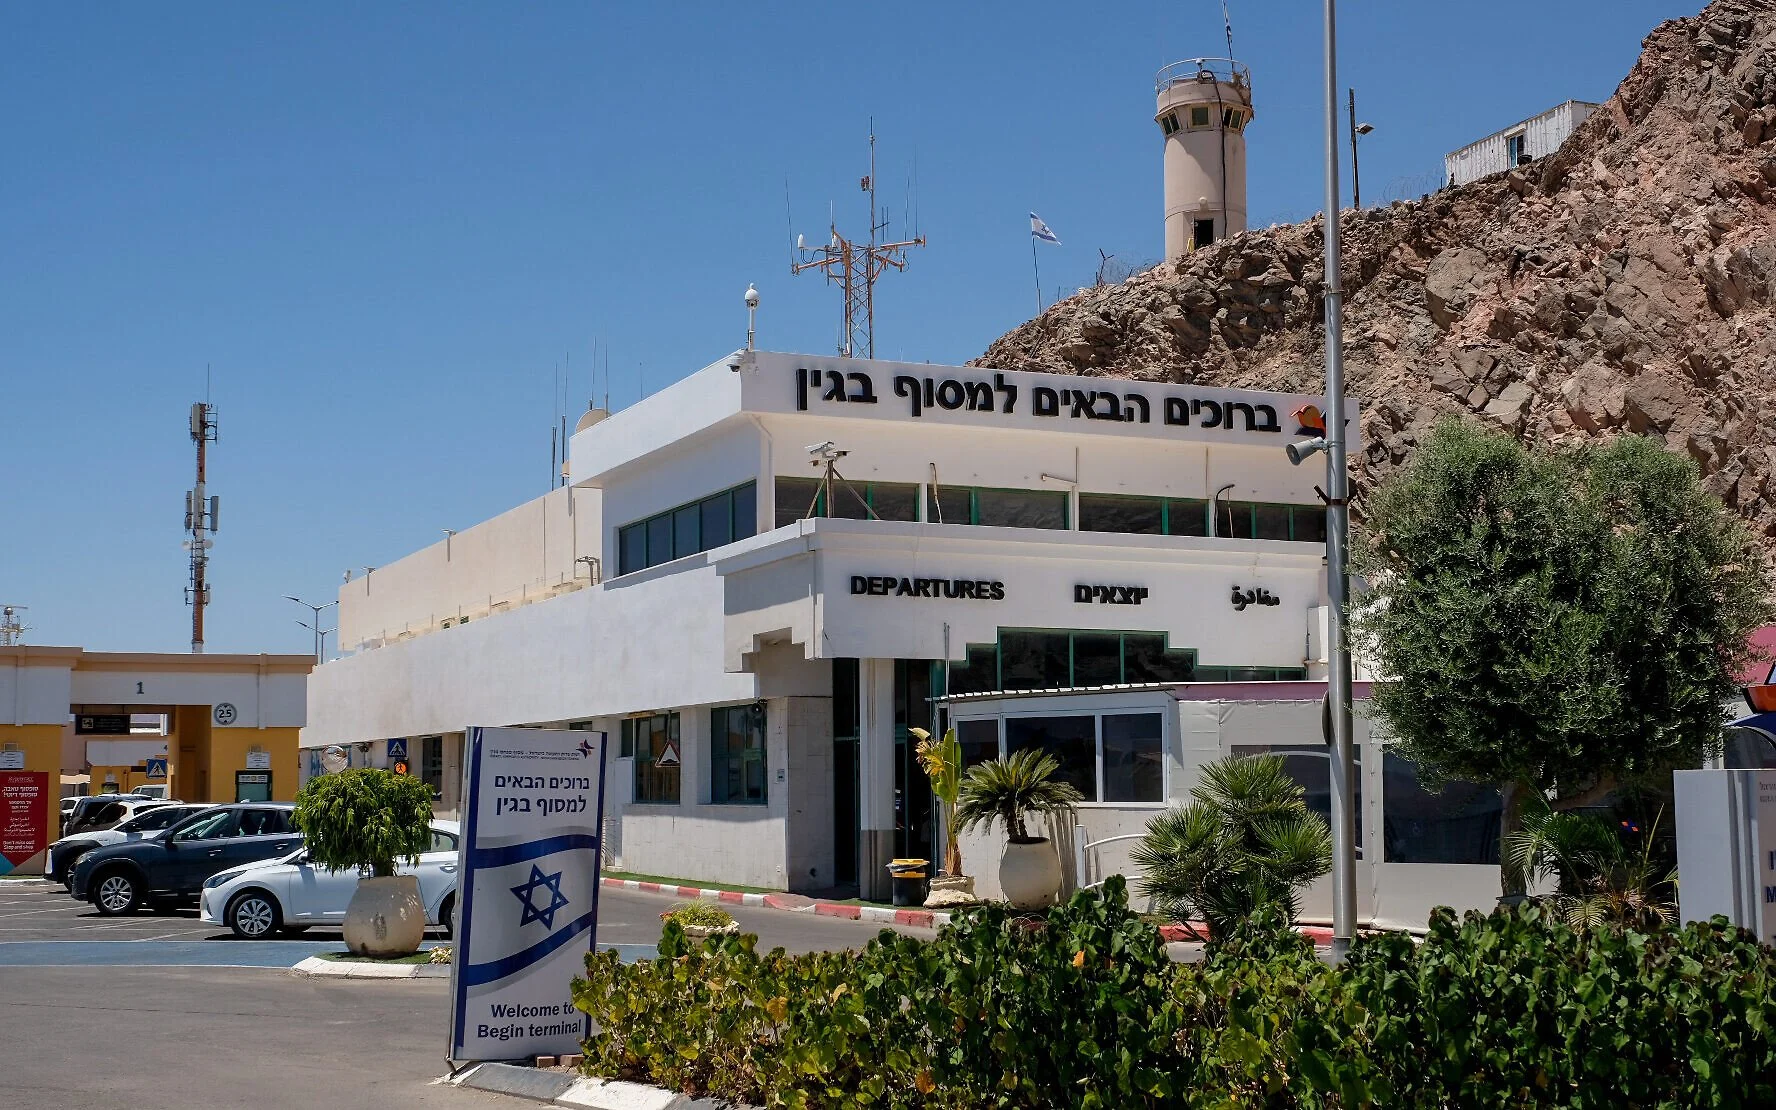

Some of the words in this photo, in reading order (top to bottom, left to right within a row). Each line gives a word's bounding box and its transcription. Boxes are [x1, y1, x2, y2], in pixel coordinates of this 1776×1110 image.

[796, 368, 878, 411] בגין
[893, 373, 1018, 417] למסוף
[1032, 386, 1150, 423] הבאים
[1164, 396, 1281, 433] ברוכים
[850, 575, 1005, 600] DEPARTURES
[1074, 584, 1149, 605] יוצאים
[1231, 585, 1280, 611] مغادرة
[136, 681, 145, 695] 1
[494, 775, 545, 789] הבאים
[549, 777, 590, 790] ברוכים
[496, 797, 531, 815] בגין
[536, 795, 587, 816] למסוף
[491, 1003, 560, 1018] Welcome
[563, 1001, 575, 1014] to
[478, 1023, 524, 1041] Begin
[529, 1019, 582, 1037] terminal
